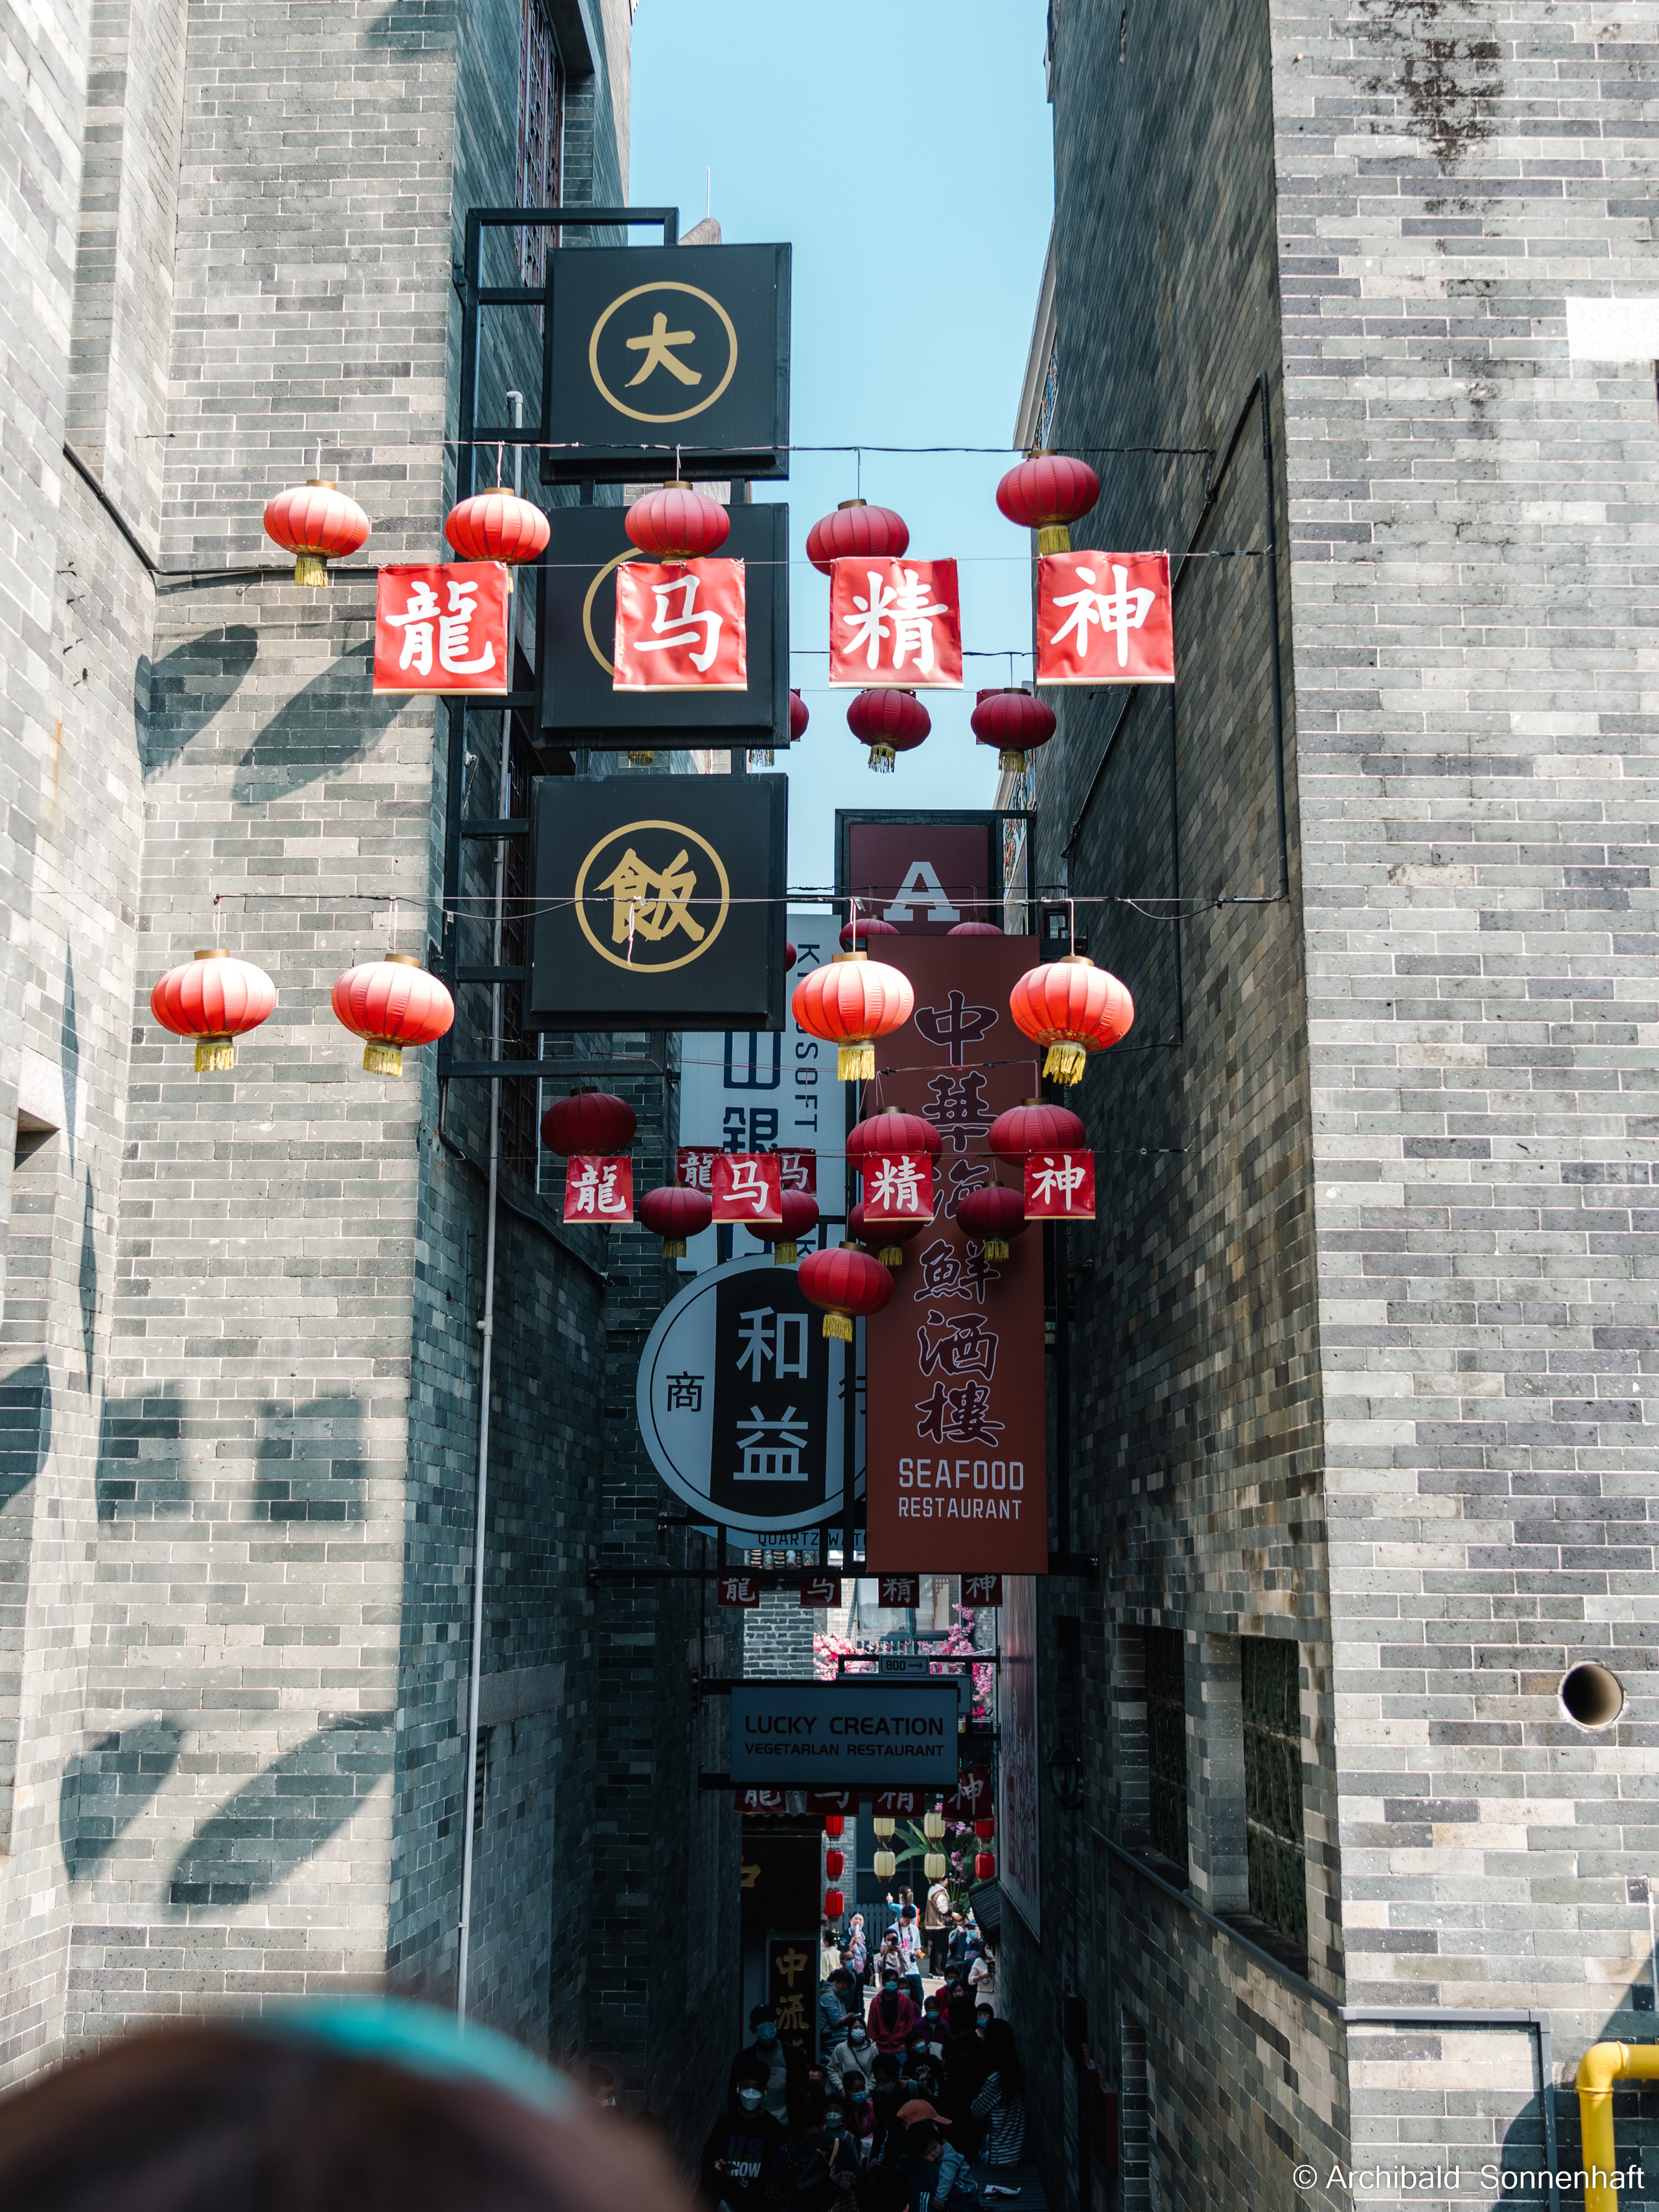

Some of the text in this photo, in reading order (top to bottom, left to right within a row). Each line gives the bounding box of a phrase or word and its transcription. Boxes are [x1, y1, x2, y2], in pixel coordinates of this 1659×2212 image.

[625, 312, 702, 388] 大
[385, 564, 1156, 676] 龍 马 精 神
[593, 848, 705, 944] 飯
[883, 861, 960, 922] A
[570, 1154, 1087, 1213] 龍 马 精 神
[780, 1154, 809, 1190] 马
[666, 1370, 705, 1413] 商
[732, 1305, 809, 1482] 和益
[899, 1458, 1024, 1491] SEAFOOD
[898, 1496, 1022, 1520] RESTAURANT
[758, 1532, 819, 1546] QUARTZ
[722, 1577, 756, 1602] 龍
[965, 1574, 997, 1602] 神
[886, 1660, 905, 1670] 800
[745, 1716, 943, 1736] LUCKY CREATION
[847, 1744, 944, 1756] RESTAURANT
[947, 1773, 985, 1815] 神
